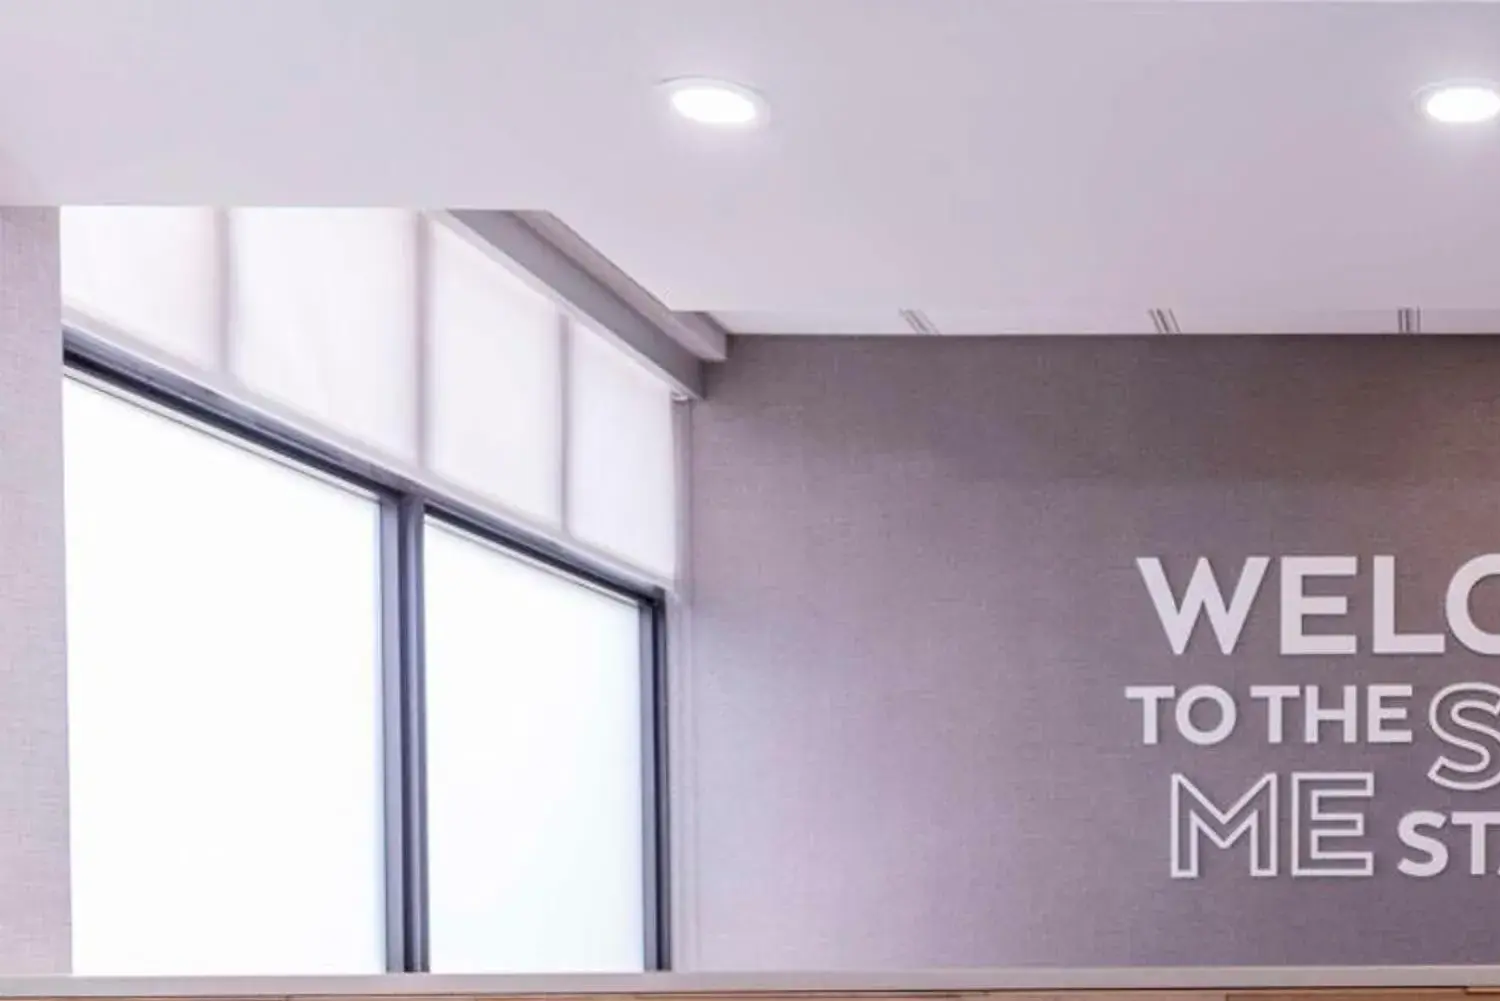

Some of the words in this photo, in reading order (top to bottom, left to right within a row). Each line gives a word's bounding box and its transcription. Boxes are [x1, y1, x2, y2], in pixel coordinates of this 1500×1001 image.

[1125, 685, 1237, 745] TO
[1250, 685, 1413, 744] THE
[1170, 771, 1375, 878] ME
